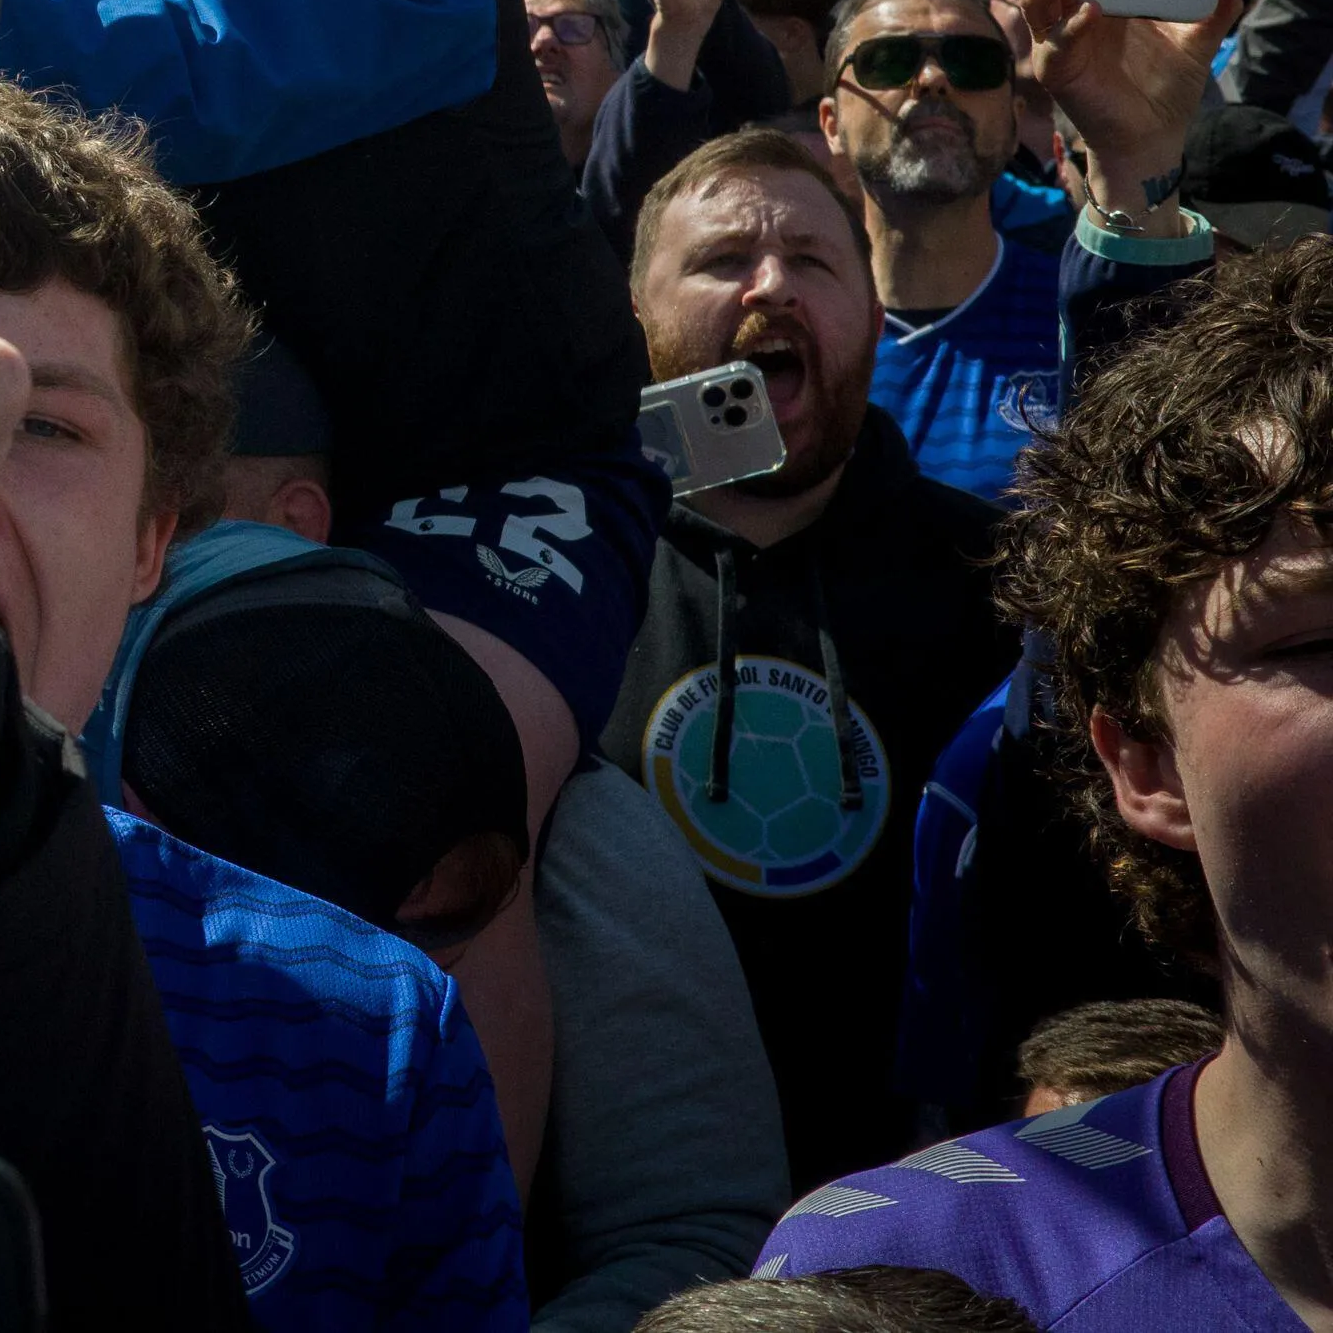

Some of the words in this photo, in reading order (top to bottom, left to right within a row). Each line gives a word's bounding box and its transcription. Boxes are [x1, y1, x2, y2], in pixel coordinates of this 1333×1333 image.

[484, 573, 541, 606] STORE
[655, 708, 685, 752] CLUB
[679, 685, 701, 712] DE
[698, 665, 761, 698] FÚBOL
[768, 668, 828, 706] SANTO
[243, 1251, 283, 1287] TIMUM
